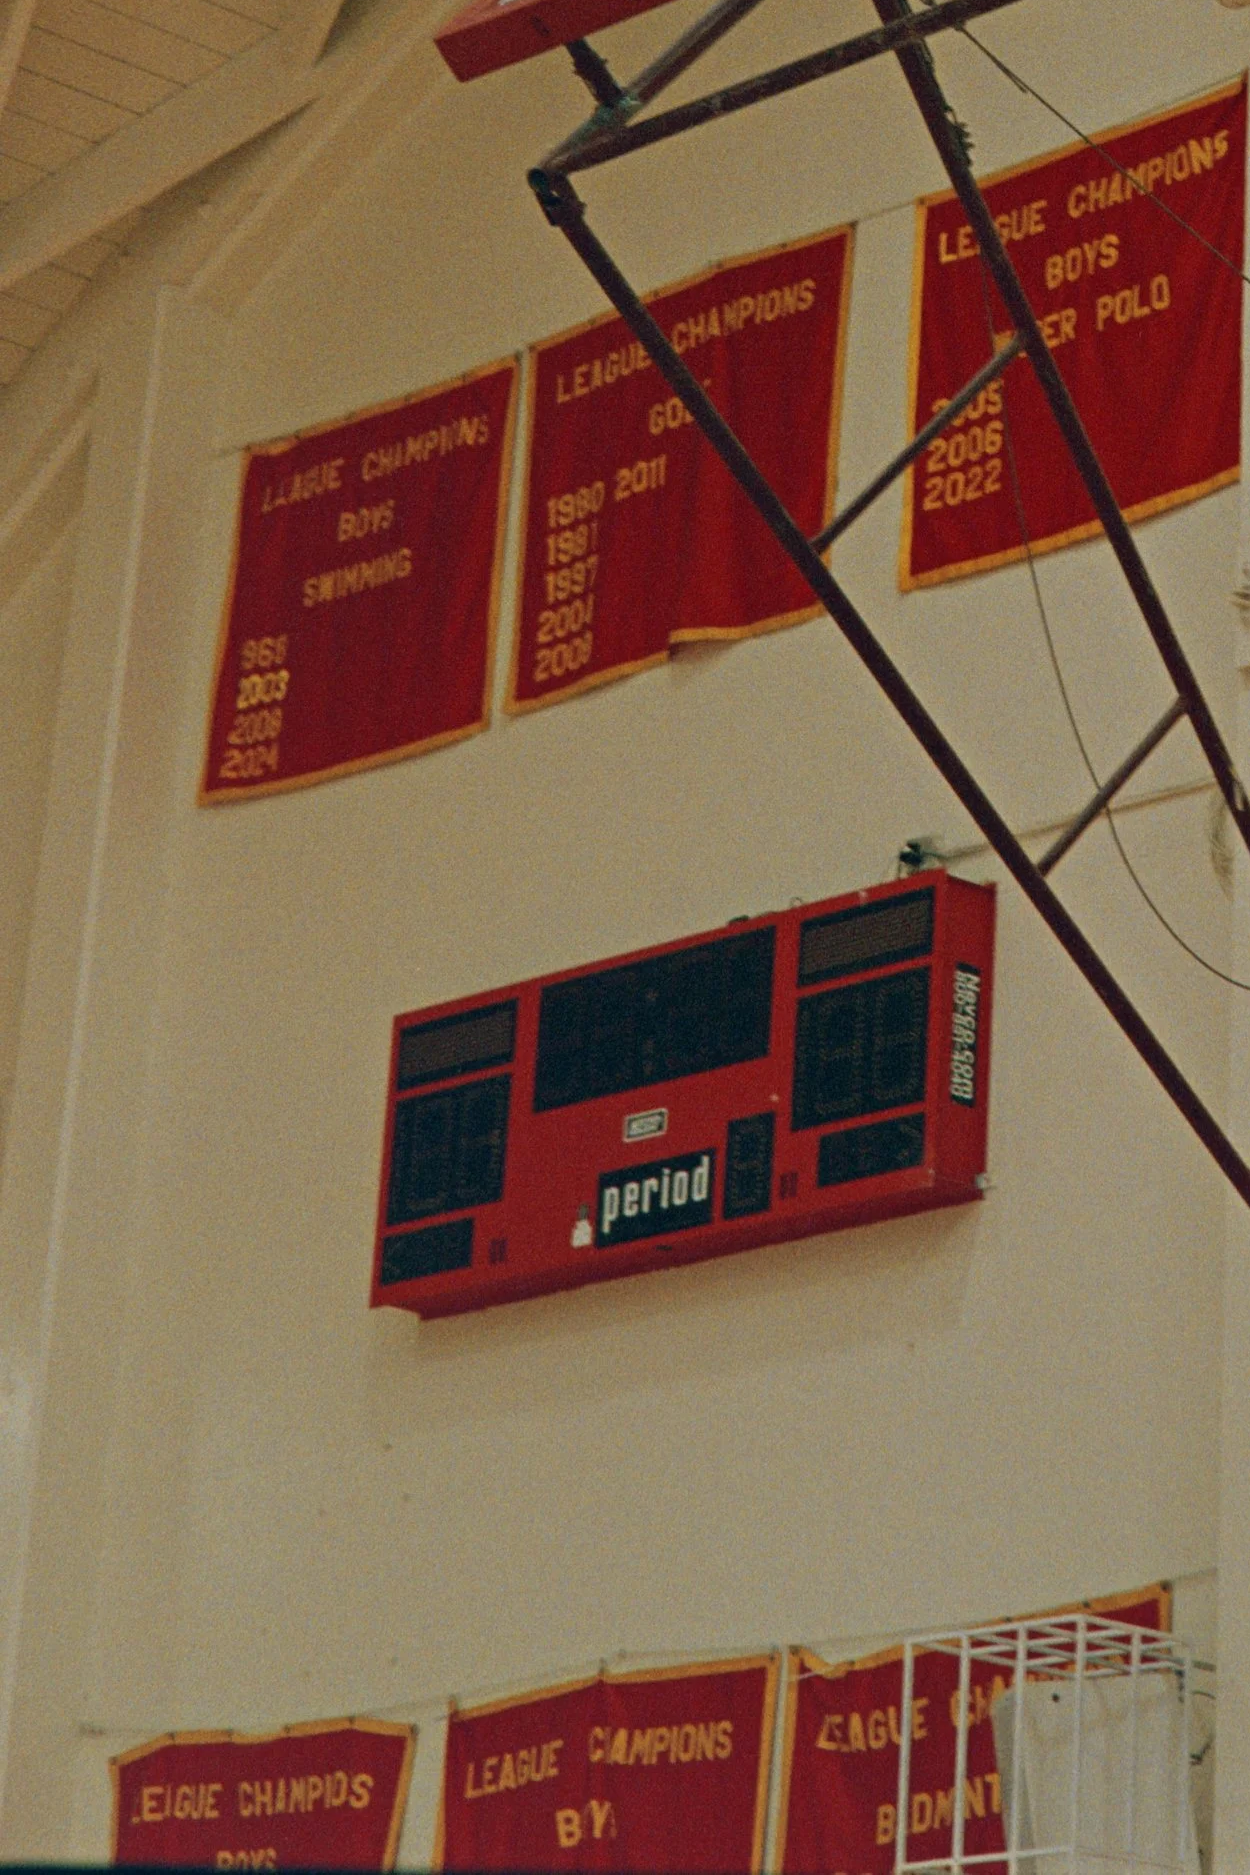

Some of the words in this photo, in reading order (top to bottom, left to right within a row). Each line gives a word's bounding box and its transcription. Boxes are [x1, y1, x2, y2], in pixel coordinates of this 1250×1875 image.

[939, 200, 1048, 265] LEGUE
[1067, 130, 1230, 220] CHAMPIONS
[1044, 233, 1121, 291] BOYS
[669, 278, 817, 354] CHAMPIONS
[1096, 273, 1171, 331] POLO
[926, 420, 1004, 473] 2006
[614, 454, 667, 503] 2011
[922, 458, 1003, 512] 2022
[302, 547, 414, 608] SWIMMING
[601, 1154, 712, 1234] period
[238, 1769, 375, 1818] CHAMPIOS
[463, 1737, 566, 1800] LEAGUE
